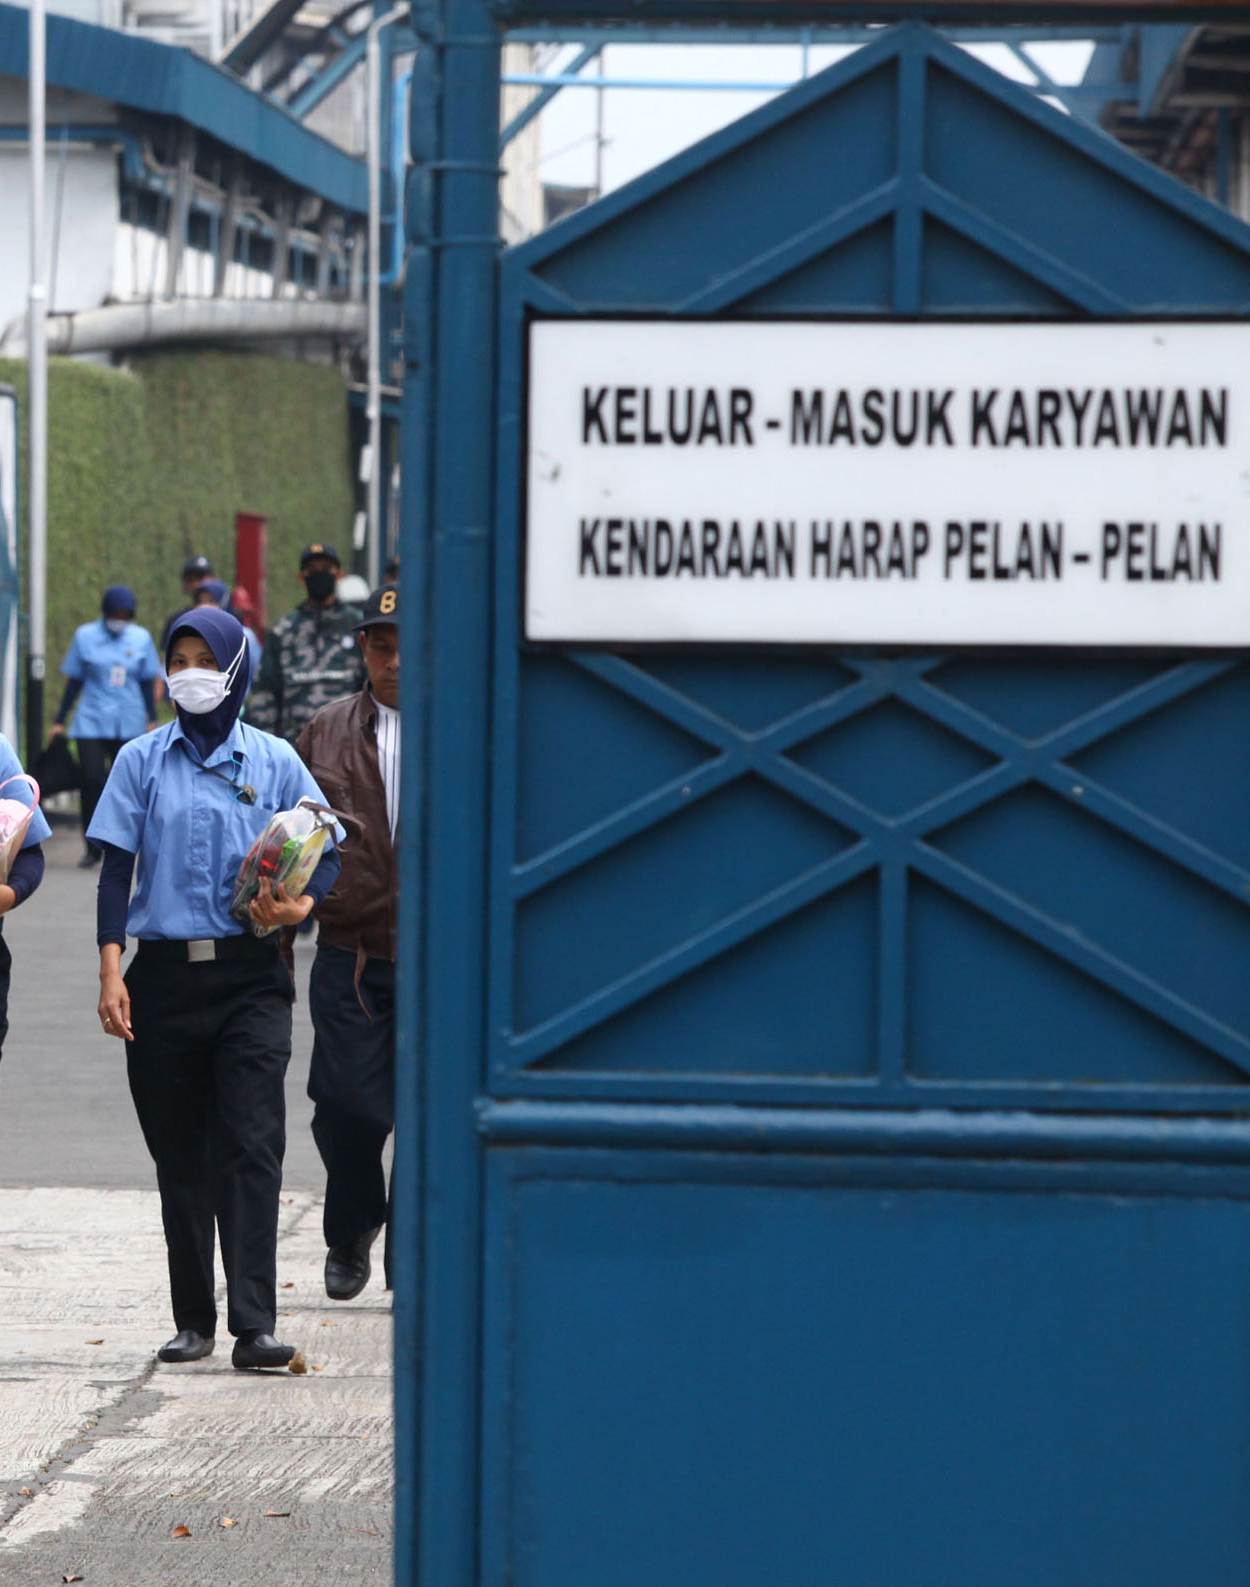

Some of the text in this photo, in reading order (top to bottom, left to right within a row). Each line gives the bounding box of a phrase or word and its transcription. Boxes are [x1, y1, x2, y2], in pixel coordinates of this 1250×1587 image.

[581, 386, 755, 446] KELUAR
[791, 388, 955, 448] MASUK
[970, 388, 1229, 448] KARYAWAN
[579, 518, 797, 579] KENDARAAN
[810, 520, 931, 580] HARAP
[944, 521, 1064, 581] PELAN
[1101, 522, 1222, 582] PELAN
